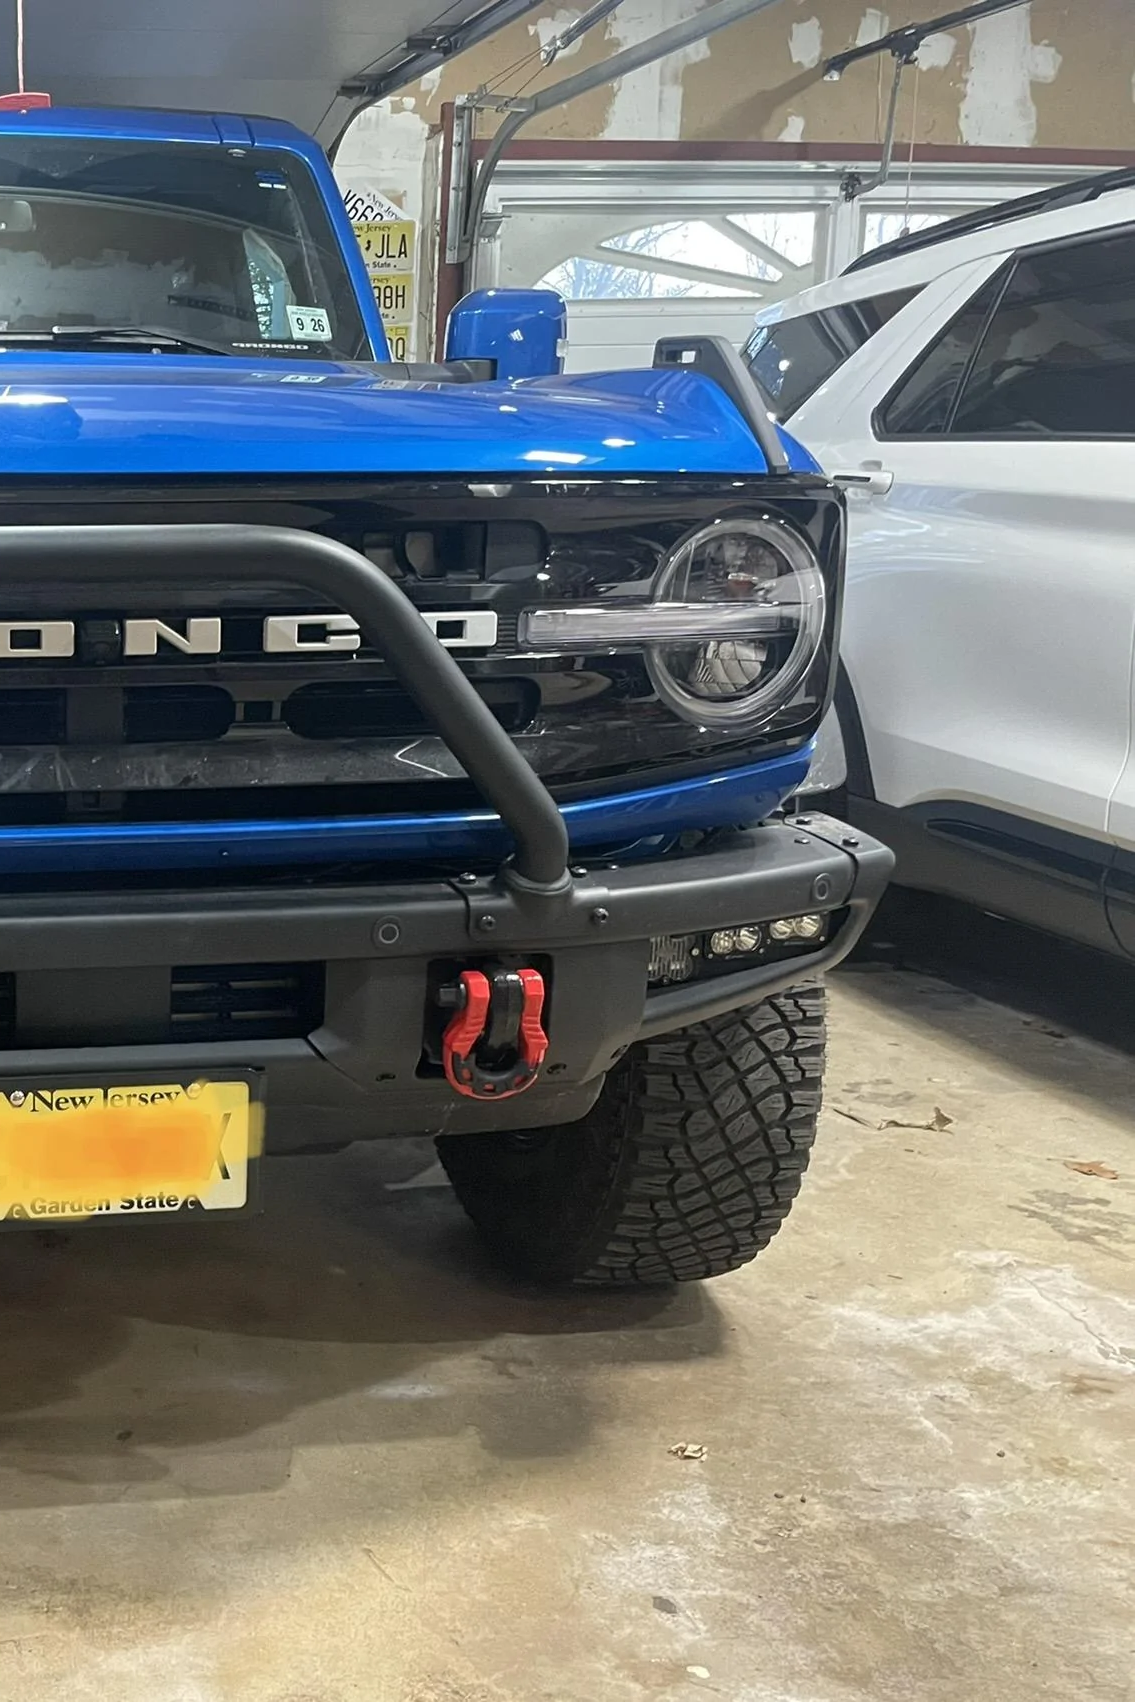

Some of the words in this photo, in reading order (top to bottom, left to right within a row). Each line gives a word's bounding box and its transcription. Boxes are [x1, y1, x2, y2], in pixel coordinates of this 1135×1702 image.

[365, 224, 392, 234] Jersey
[375, 233, 408, 259] JLA
[296, 317, 305, 332] 9
[310, 318, 325, 333] 26
[29, 1089, 95, 1113] New
[30, 1196, 112, 1216] Garden
[119, 1191, 180, 1212] State
